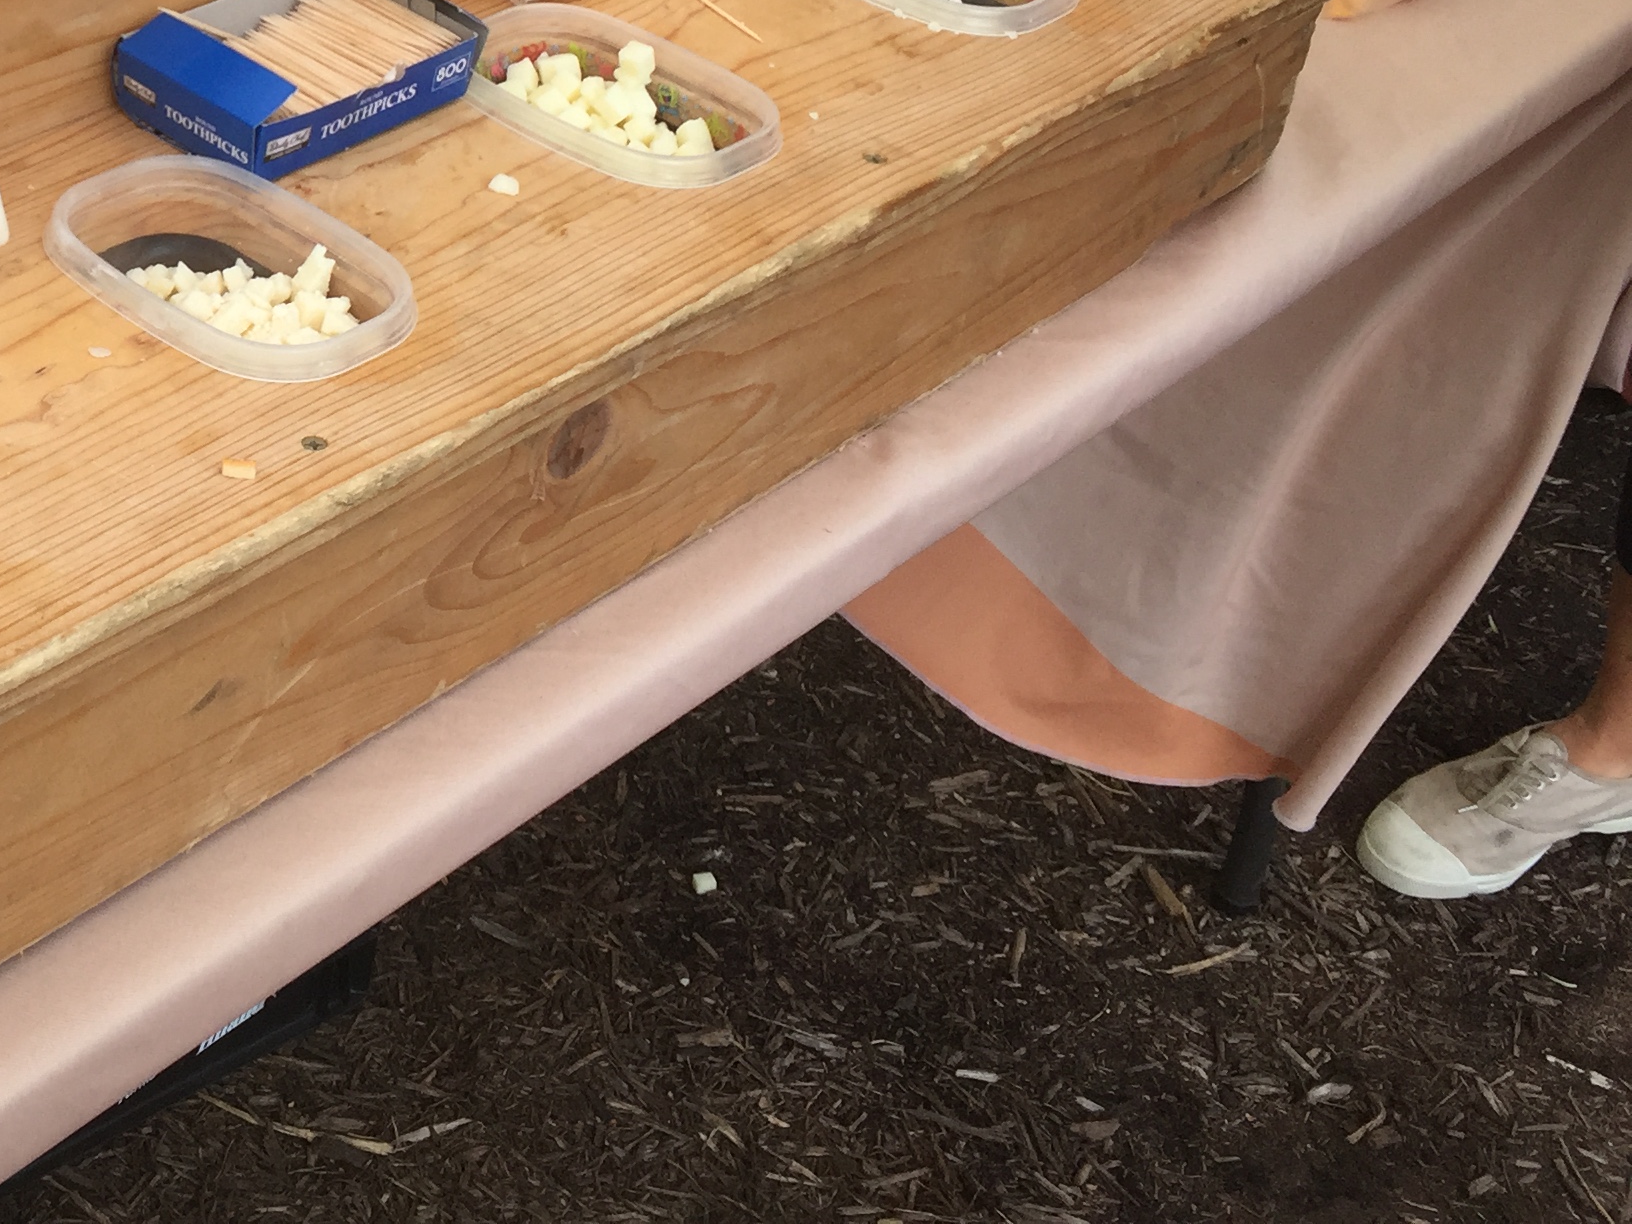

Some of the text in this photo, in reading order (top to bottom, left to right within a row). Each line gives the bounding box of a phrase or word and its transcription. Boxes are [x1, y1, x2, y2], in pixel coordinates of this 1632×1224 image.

[436, 57, 468, 83] 800
[164, 104, 249, 165] TOOTHPICKS
[320, 82, 418, 140] TOOTHPICKS
